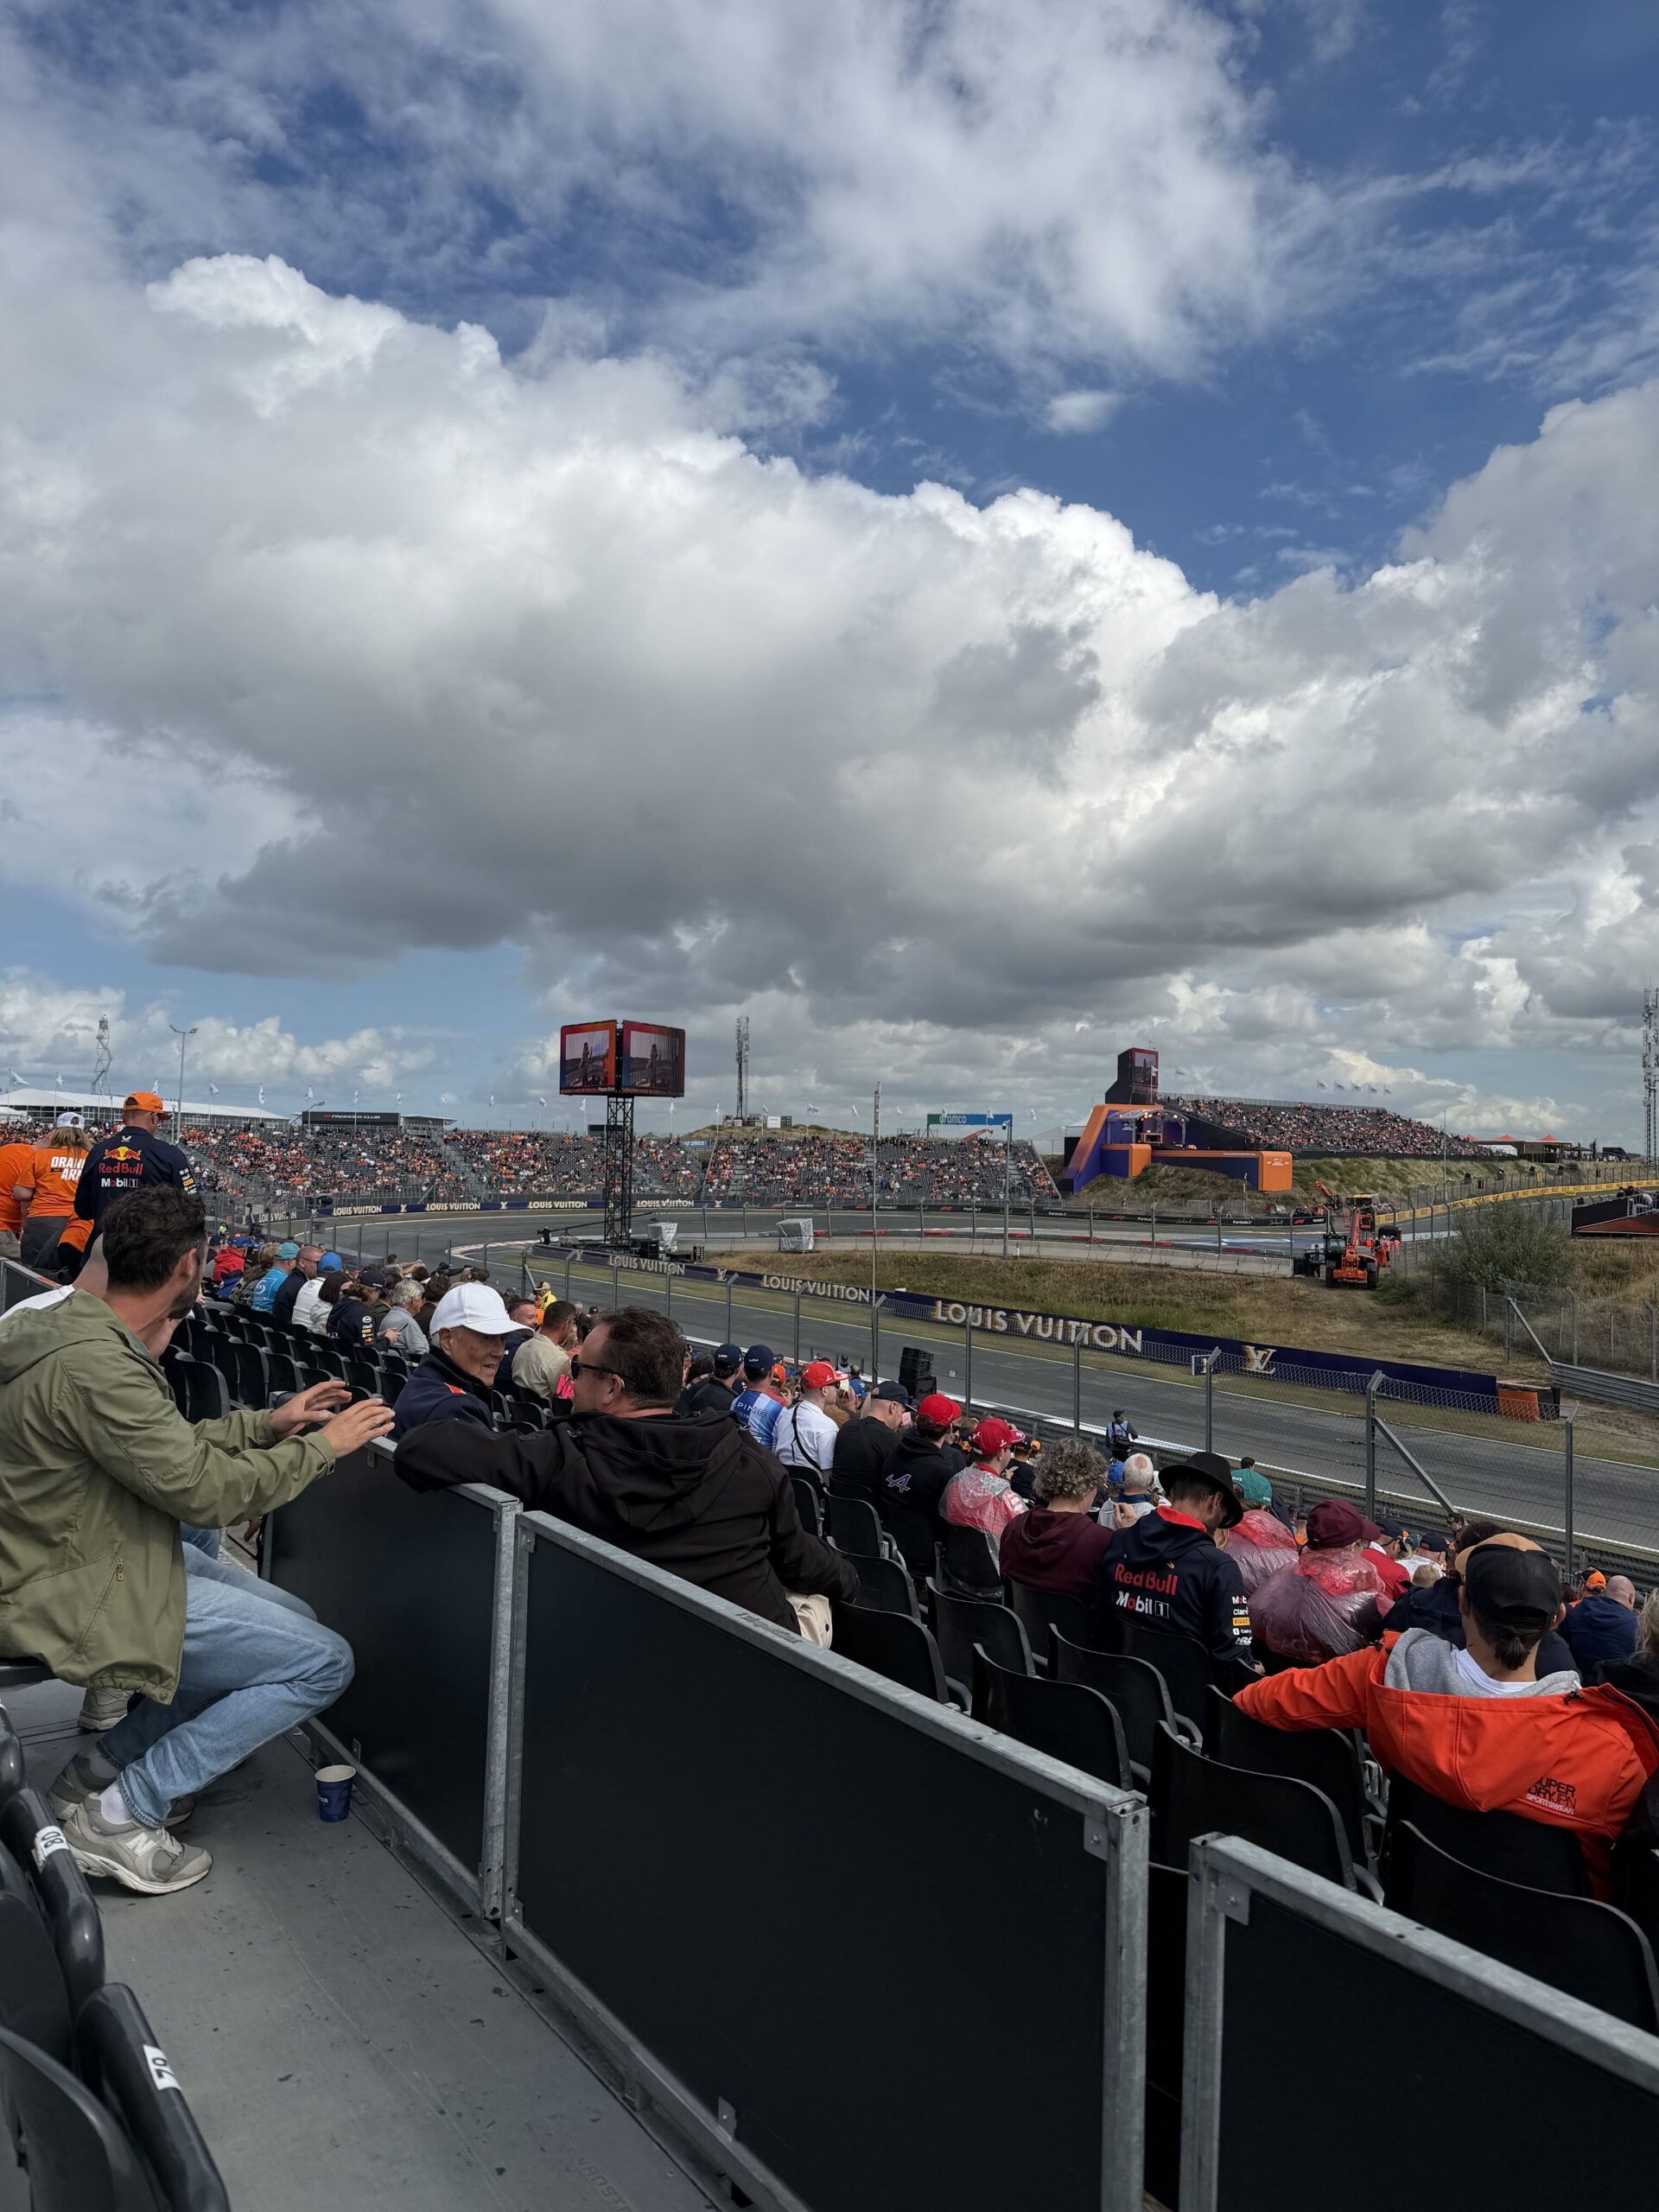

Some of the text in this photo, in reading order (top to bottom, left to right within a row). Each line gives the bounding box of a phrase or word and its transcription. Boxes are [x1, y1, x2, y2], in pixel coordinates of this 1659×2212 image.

[101, 1178, 128, 1188] Mobil
[333, 1205, 382, 1217] LOUIS VUITTON
[426, 1202, 480, 1211] LOUIS VUITTON
[609, 1255, 685, 1275] LOUIS VUITTON
[762, 1274, 869, 1302] LOUIS VUITTON
[936, 1300, 1142, 1352] LOUIS VUITTON
[1116, 1591, 1153, 1615] Mobil
[1527, 1784, 1556, 1802] DRY
[1526, 1792, 1575, 1815] SPORTSWEAR
